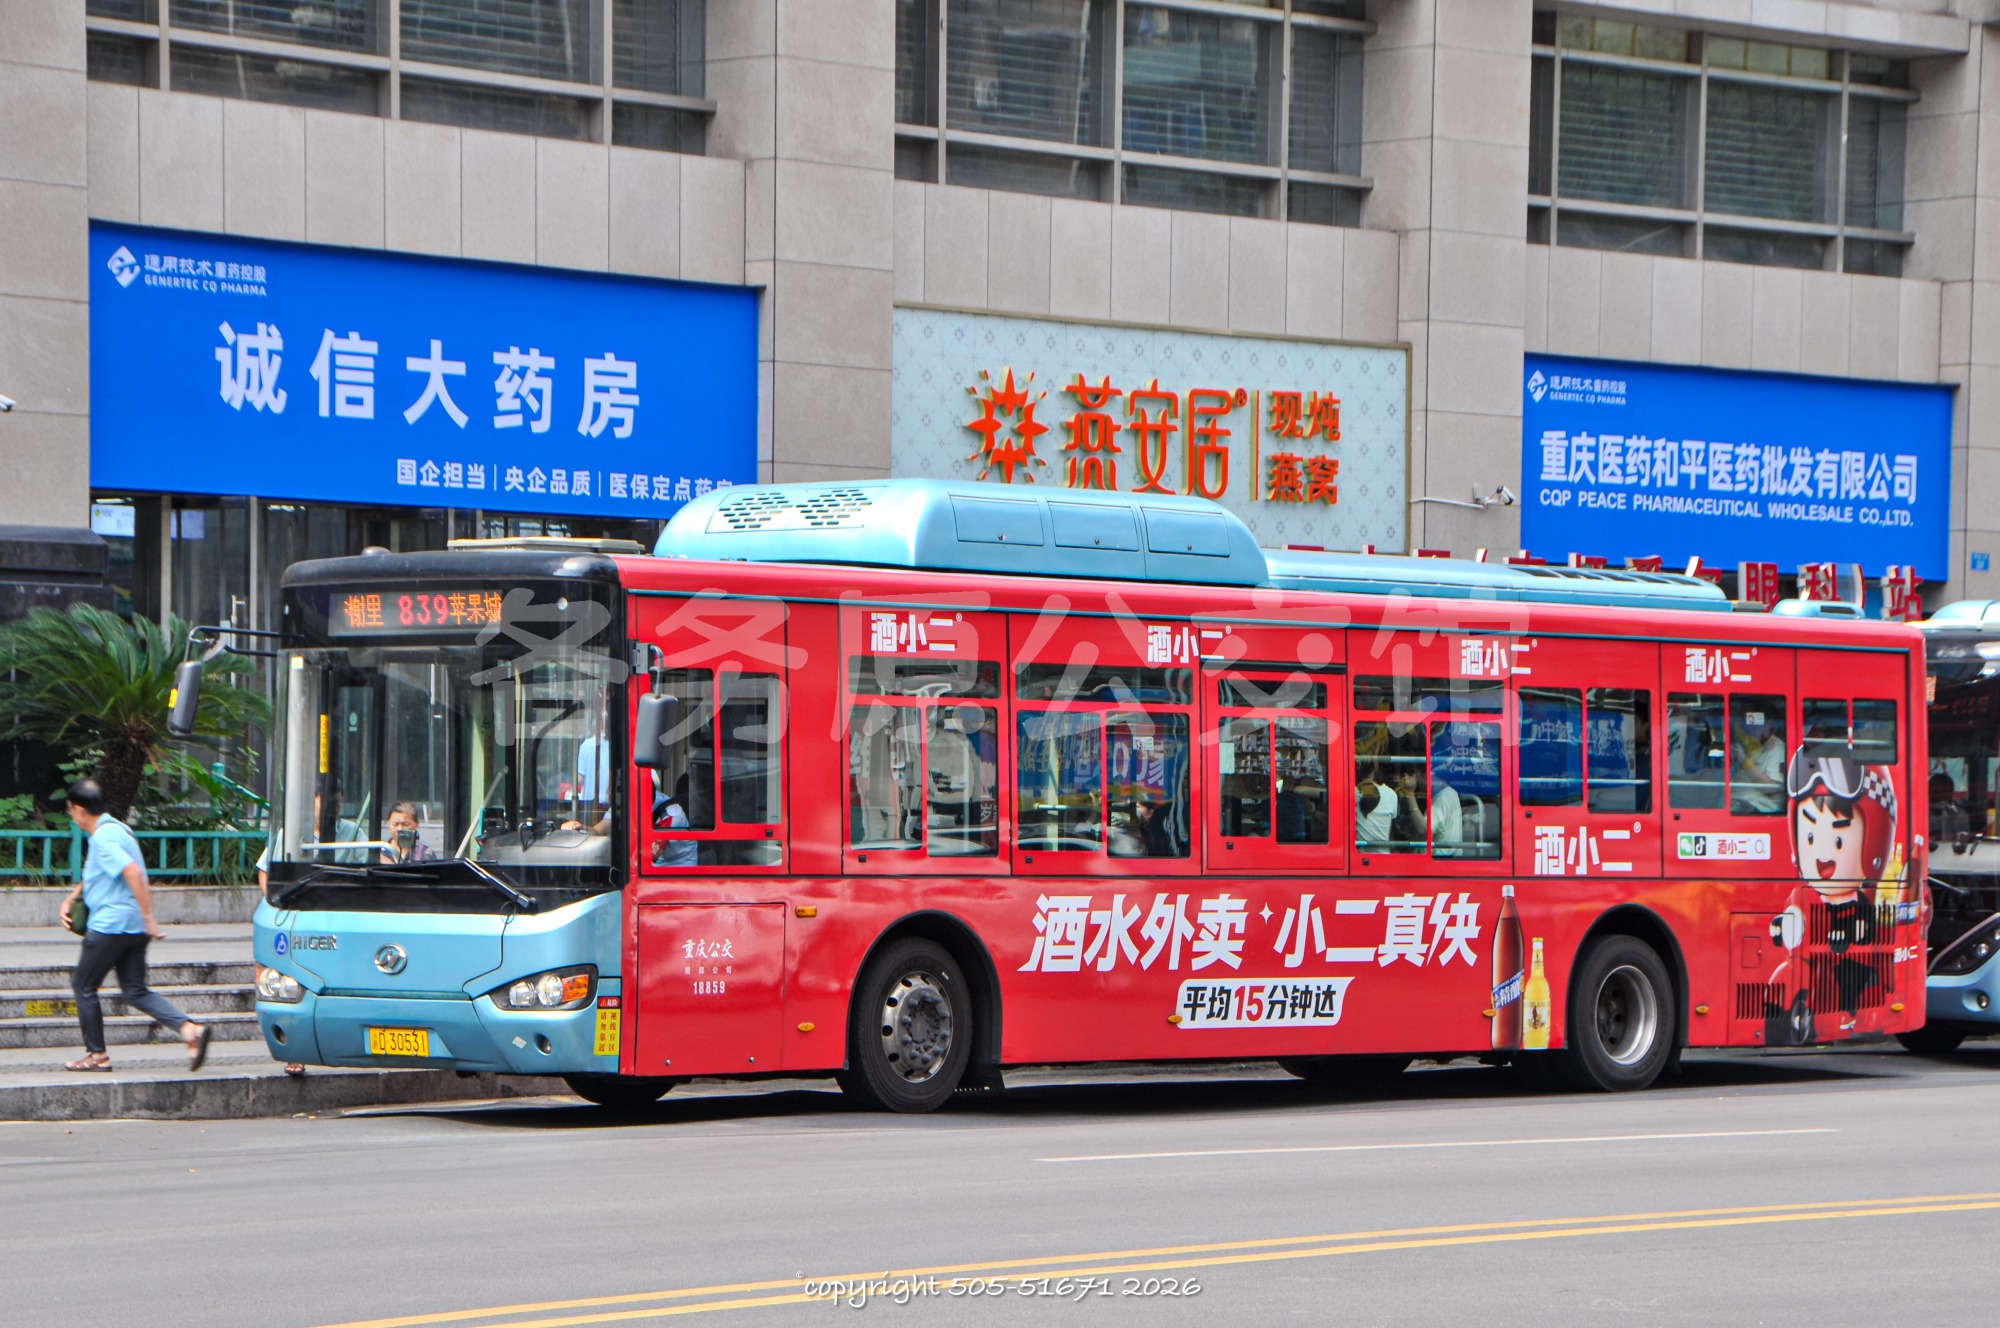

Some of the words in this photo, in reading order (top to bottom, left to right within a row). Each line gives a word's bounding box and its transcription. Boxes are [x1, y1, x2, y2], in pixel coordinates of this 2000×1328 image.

[144, 273, 199, 291] GENERTEC
[202, 280, 217, 293] CQ
[221, 281, 267, 297] PHARMA
[214, 319, 640, 439] 诚信大药房
[1267, 389, 1341, 442] 现炖
[396, 458, 486, 490] 国企担当
[504, 465, 591, 497] 央企品质
[1267, 451, 1339, 504] 燕窝
[1540, 430, 1918, 505] 重庆医药和平医药批发有限公司
[1540, 488, 1572, 507] CQP
[1578, 491, 1626, 510] PEACE
[1633, 493, 1763, 519] PHARMACEUTICAL
[1768, 503, 1854, 523] WHOLESALE
[397, 594, 449, 625] 839
[291, 934, 337, 951] HIGER
[681, 938, 735, 959] 重庆公交
[693, 980, 726, 995] 18859
[1183, 984, 1337, 1021] 平均15分钟达
